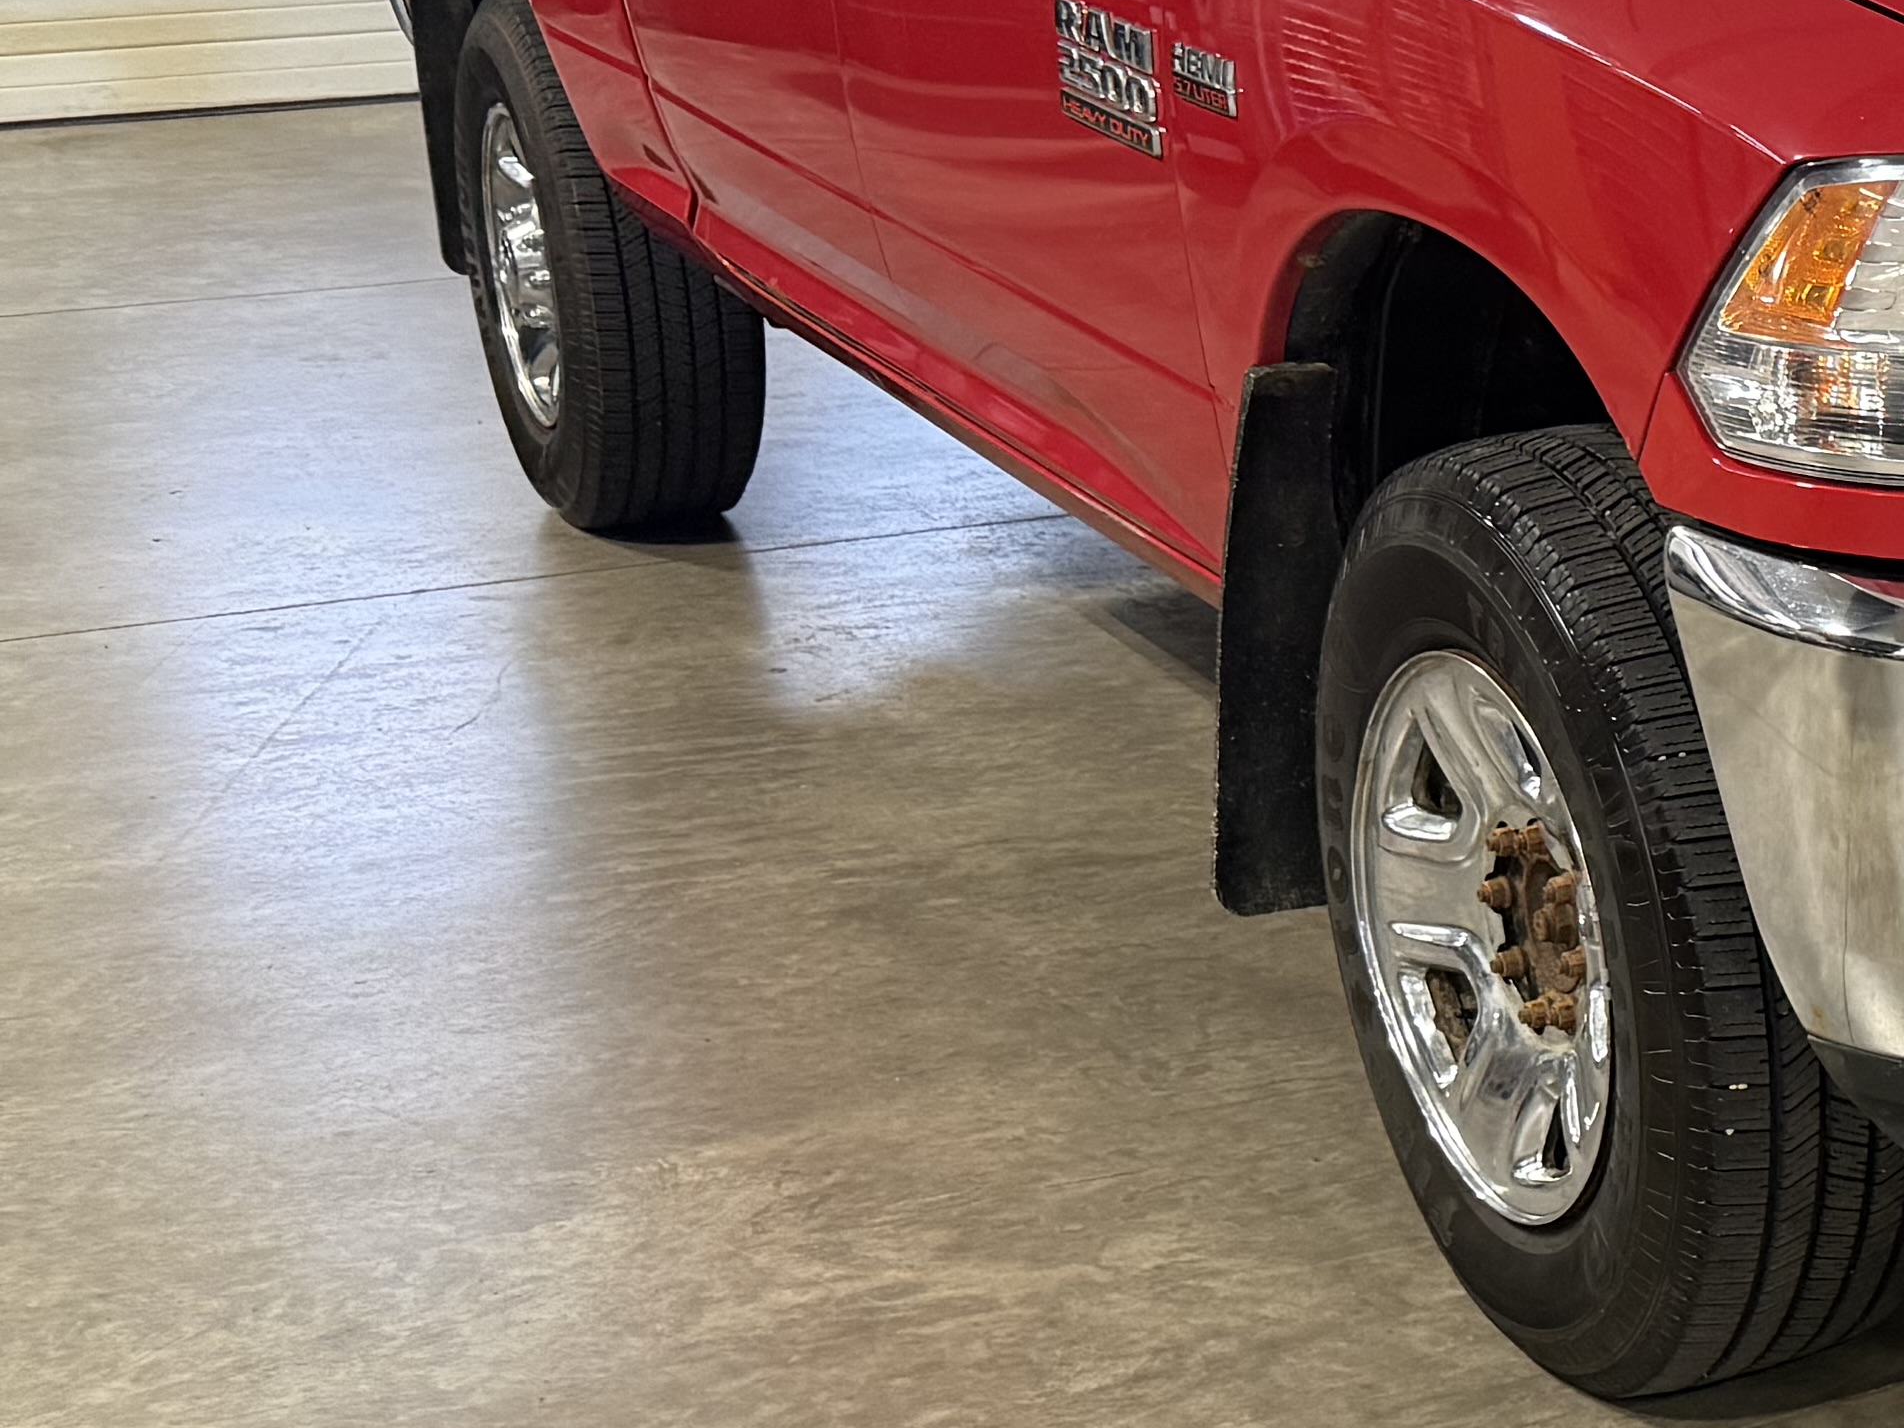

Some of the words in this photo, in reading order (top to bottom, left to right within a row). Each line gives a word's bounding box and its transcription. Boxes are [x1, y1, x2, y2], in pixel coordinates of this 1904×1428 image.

[1057, 39, 1157, 123] 2500
[1172, 41, 1235, 94] HEMI
[1063, 95, 1107, 128] HEAVY
[1109, 120, 1150, 147] DUTY
[1192, 83, 1228, 110] LITER
